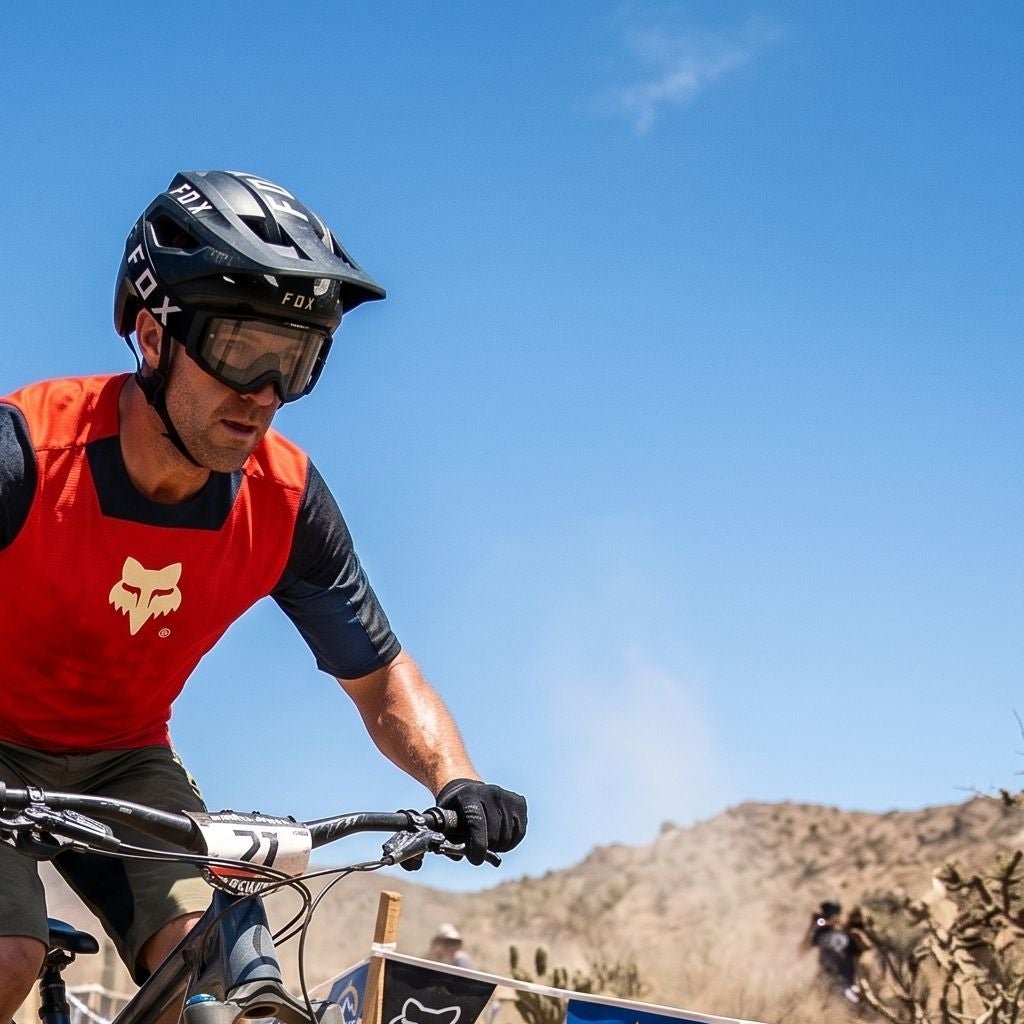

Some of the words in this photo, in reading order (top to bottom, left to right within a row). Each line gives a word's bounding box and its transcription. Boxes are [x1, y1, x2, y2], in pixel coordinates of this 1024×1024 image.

[169, 183, 213, 215] FOX
[128, 243, 183, 326] FOX
[281, 292, 315, 311] FOX
